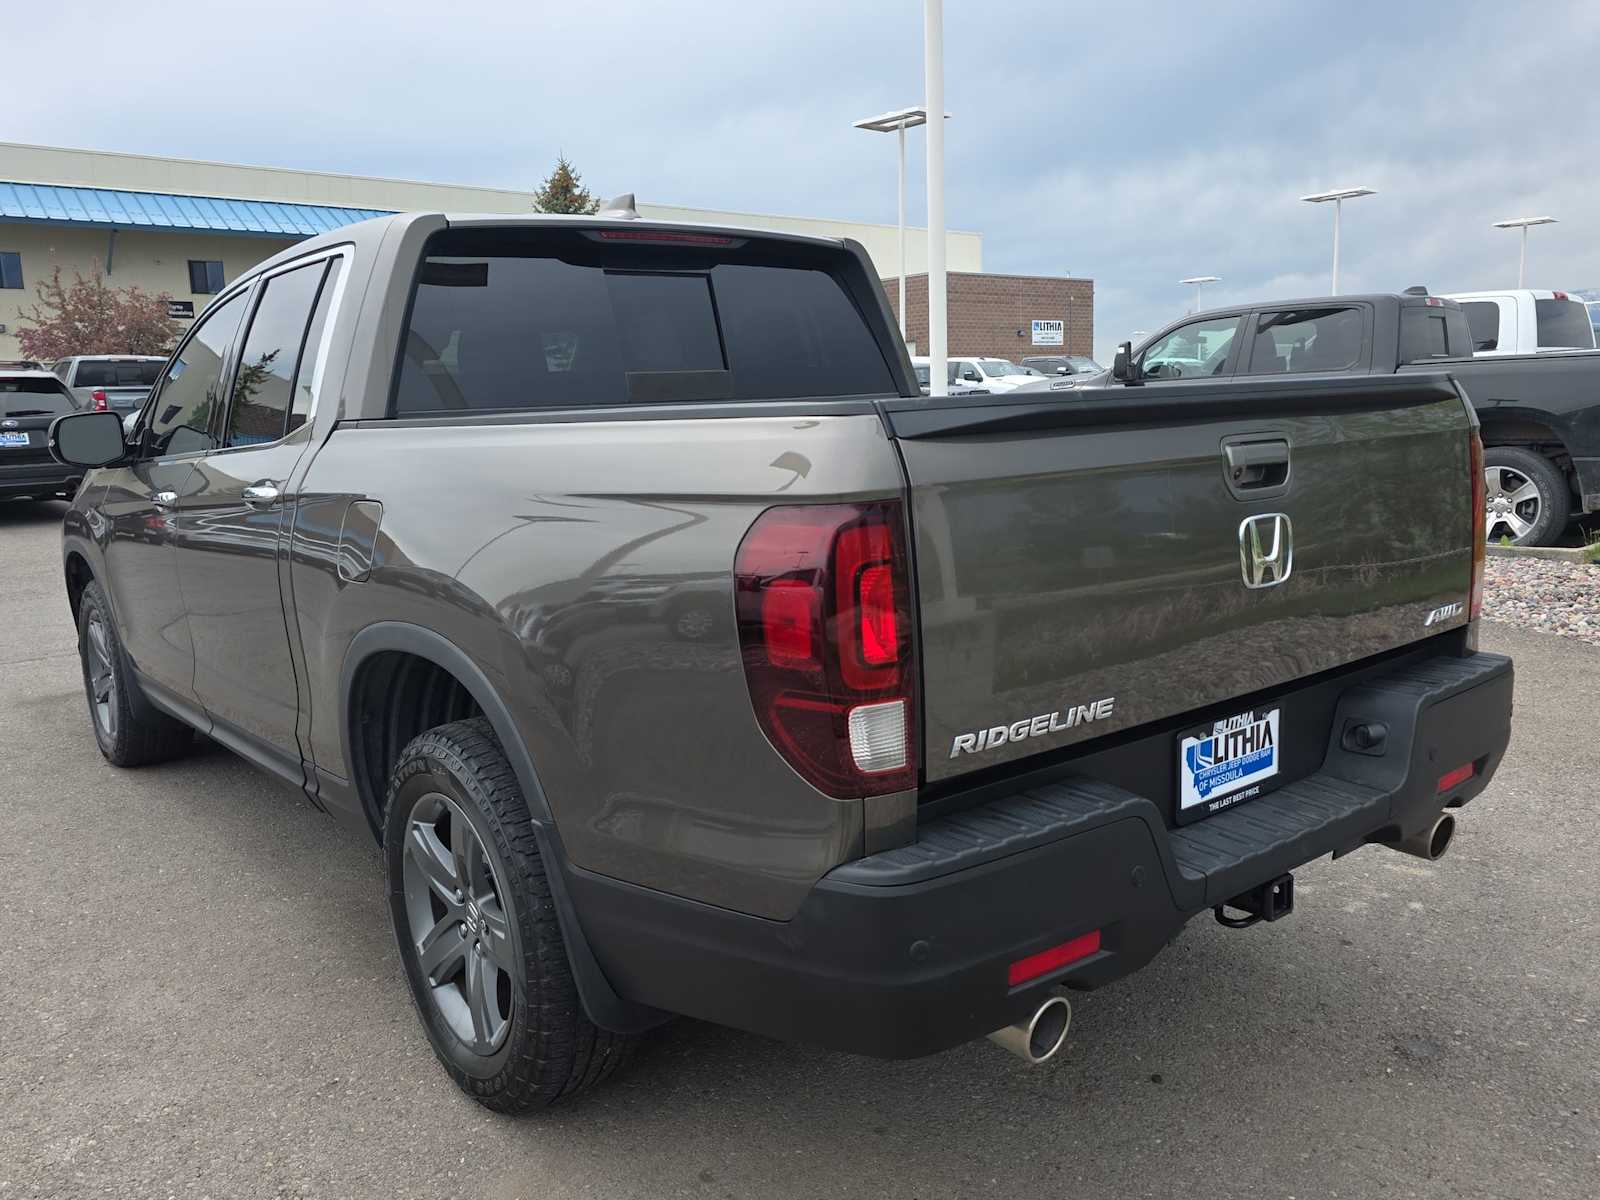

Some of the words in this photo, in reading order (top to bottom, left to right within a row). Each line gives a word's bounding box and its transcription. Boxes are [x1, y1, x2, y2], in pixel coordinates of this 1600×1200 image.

[1040, 322, 1062, 331] LITHIA
[949, 697, 1116, 759] RIDGELINE
[1224, 711, 1254, 731] LITHIA
[1214, 720, 1273, 764] LITHIA
[1198, 764, 1228, 781] CHRYSLER
[1228, 758, 1242, 771] JEEP
[1242, 752, 1260, 765] DODGE
[1260, 749, 1271, 759] RAM
[1198, 780, 1209, 792] OF
[1209, 768, 1243, 788] MISSOULA
[1209, 801, 1220, 812] THE
[1219, 796, 1233, 808] LAST
[1232, 791, 1246, 803] BEST
[1245, 786, 1260, 798] PRICE
